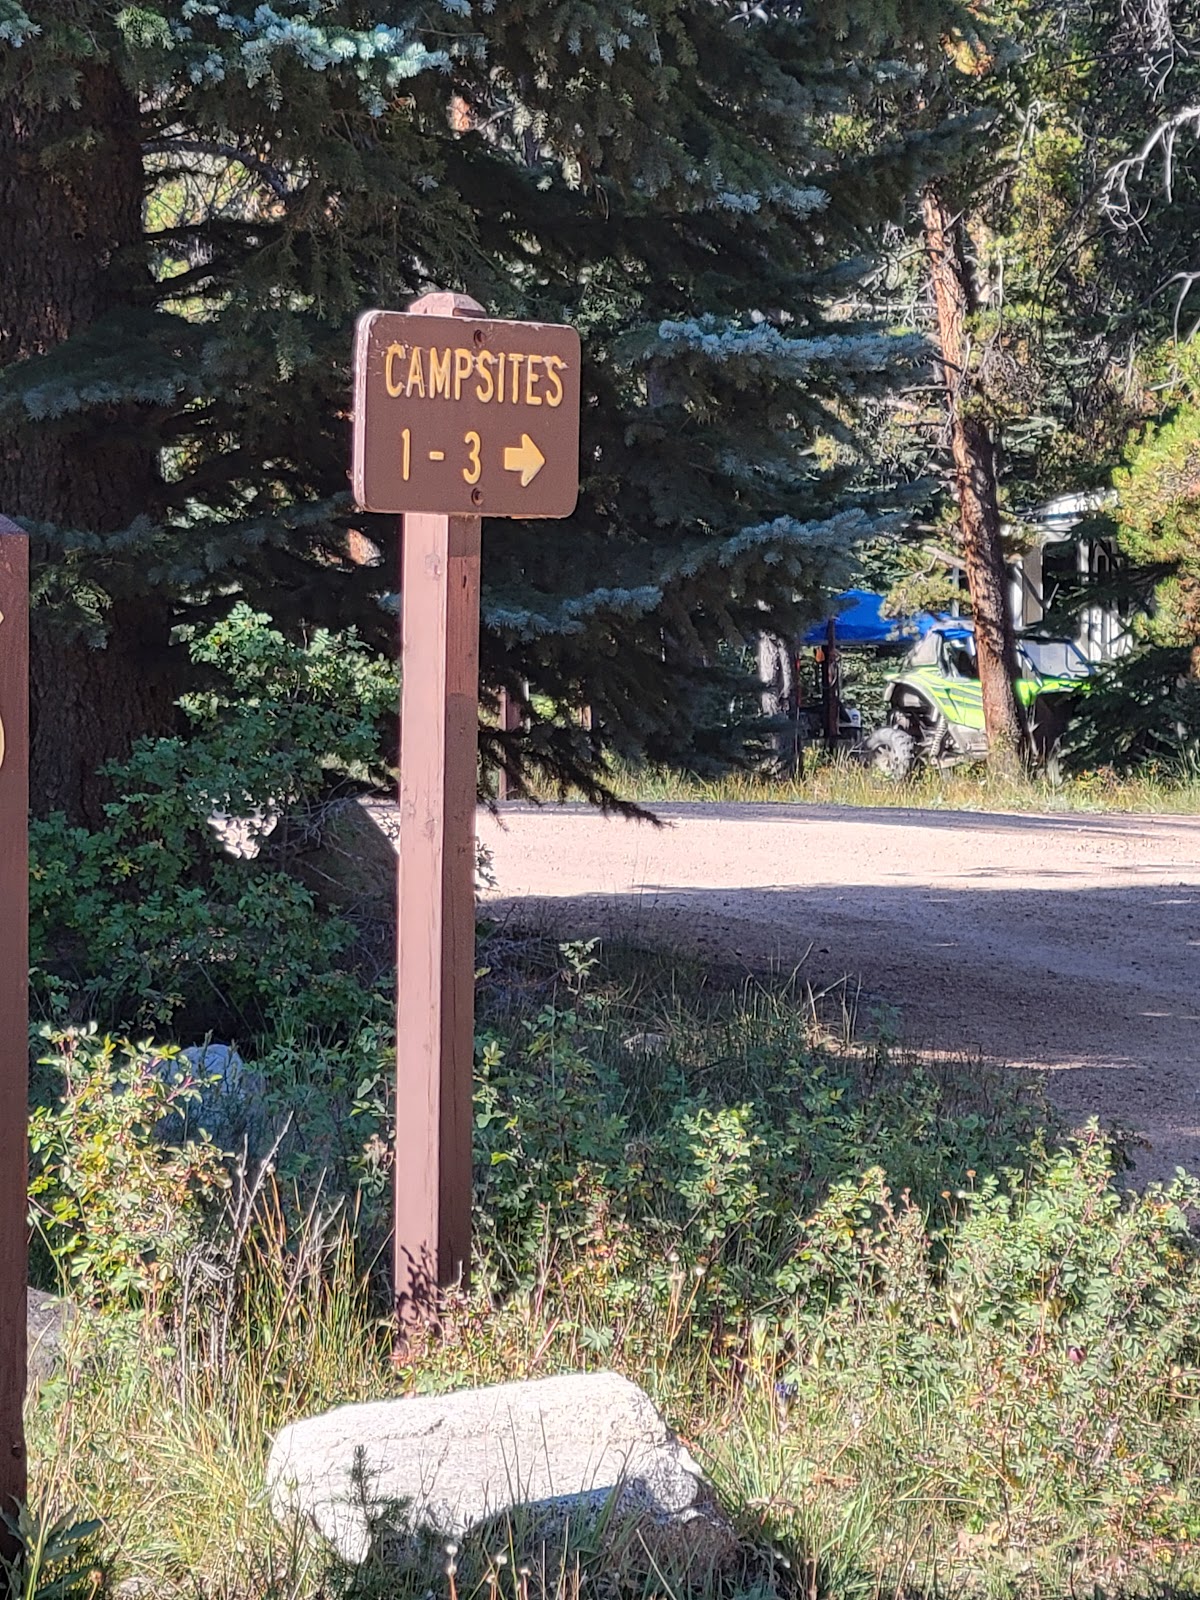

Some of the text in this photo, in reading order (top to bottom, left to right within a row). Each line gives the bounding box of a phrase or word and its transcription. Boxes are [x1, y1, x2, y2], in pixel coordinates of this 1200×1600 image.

[385, 344, 566, 407] CAMPSITES
[402, 428, 411, 481] 1
[463, 431, 481, 484] 3
